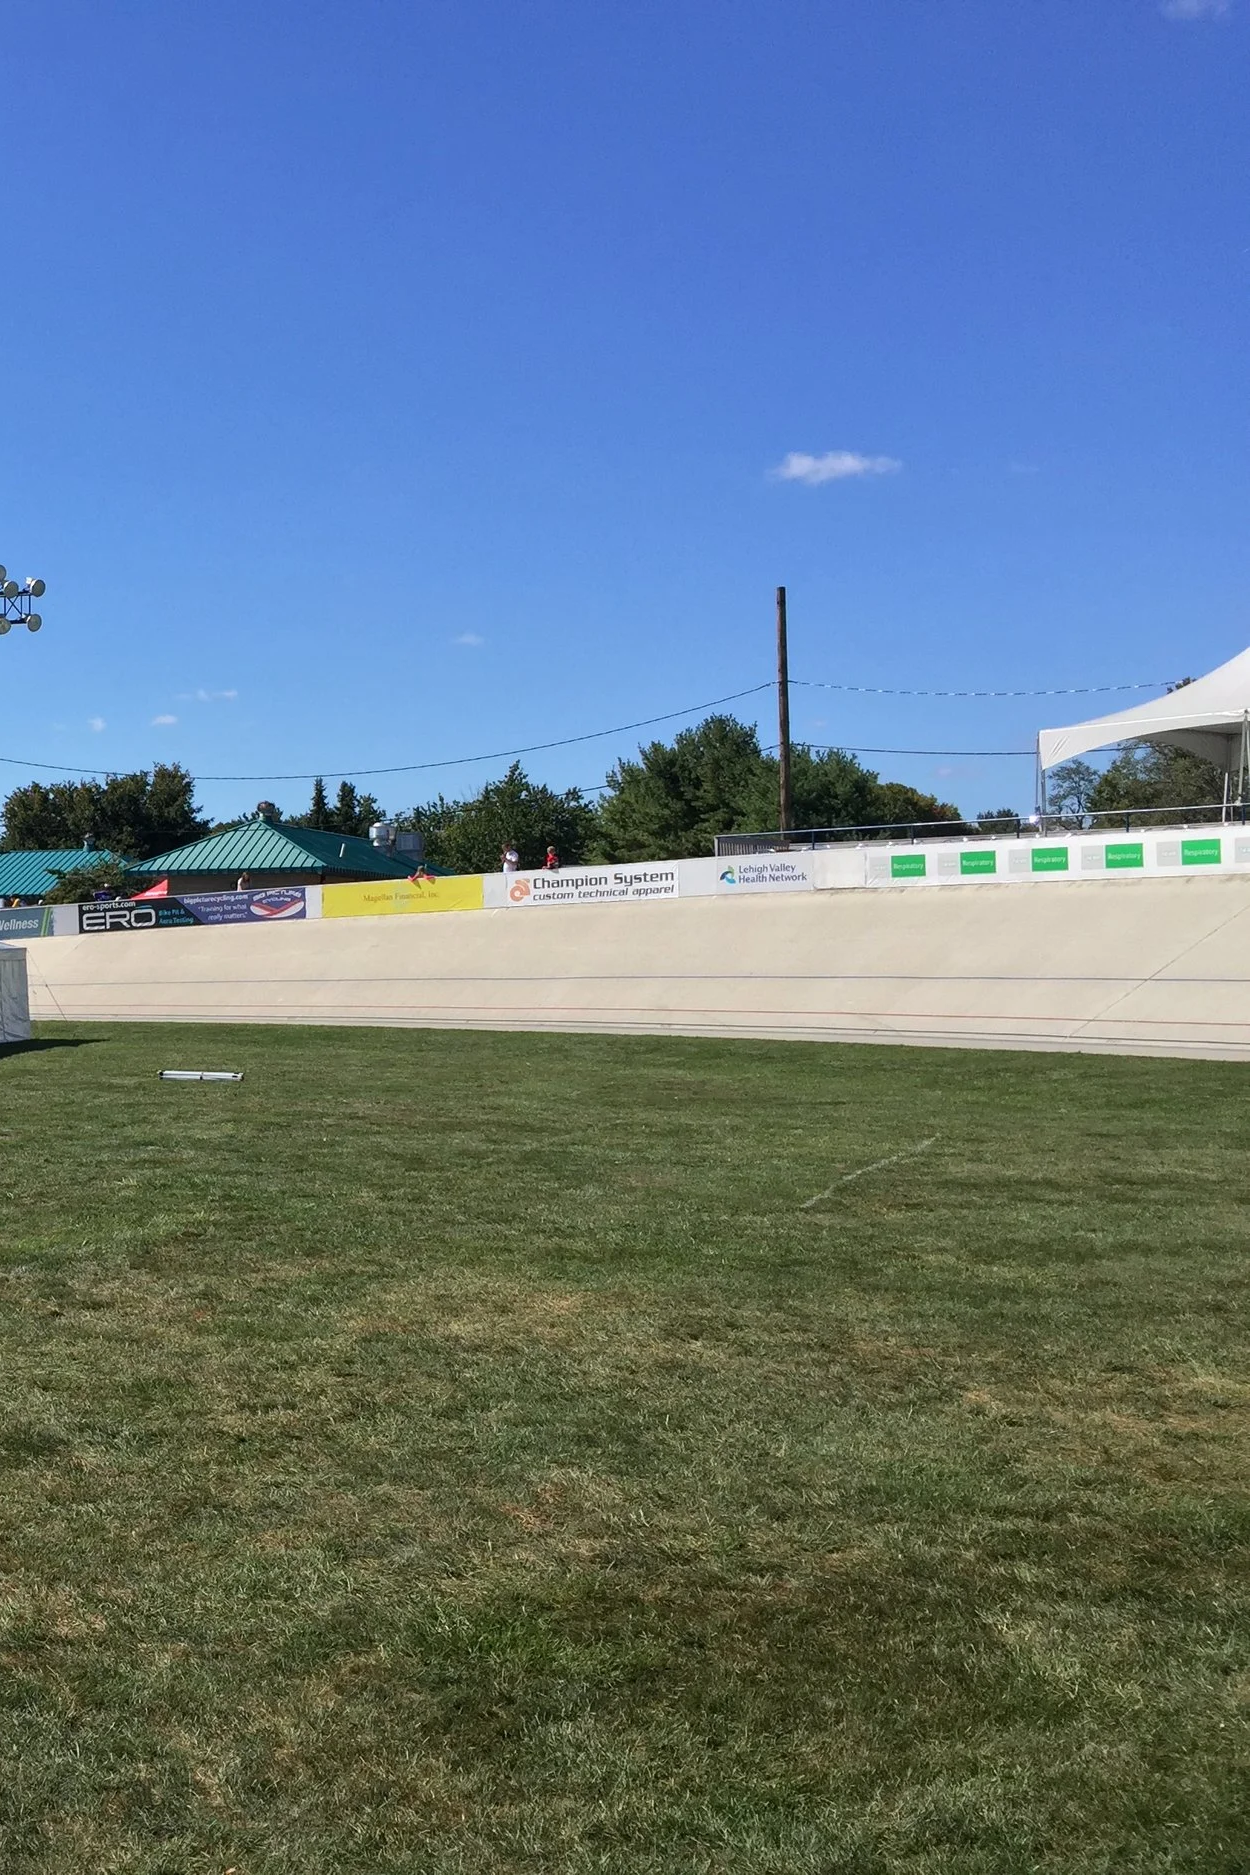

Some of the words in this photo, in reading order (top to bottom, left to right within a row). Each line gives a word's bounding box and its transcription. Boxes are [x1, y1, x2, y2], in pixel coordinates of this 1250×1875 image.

[738, 864, 768, 874] Lehigh
[769, 863, 796, 873] Valley
[533, 875, 608, 889] Champion
[613, 871, 674, 887] System
[738, 873, 767, 883] Health
[768, 872, 807, 882] Network
[363, 893, 393, 903] Magellan
[533, 892, 574, 901] custom
[578, 887, 632, 899] technical
[632, 885, 675, 897] apparel
[82, 901, 136, 912] ero-sports.com
